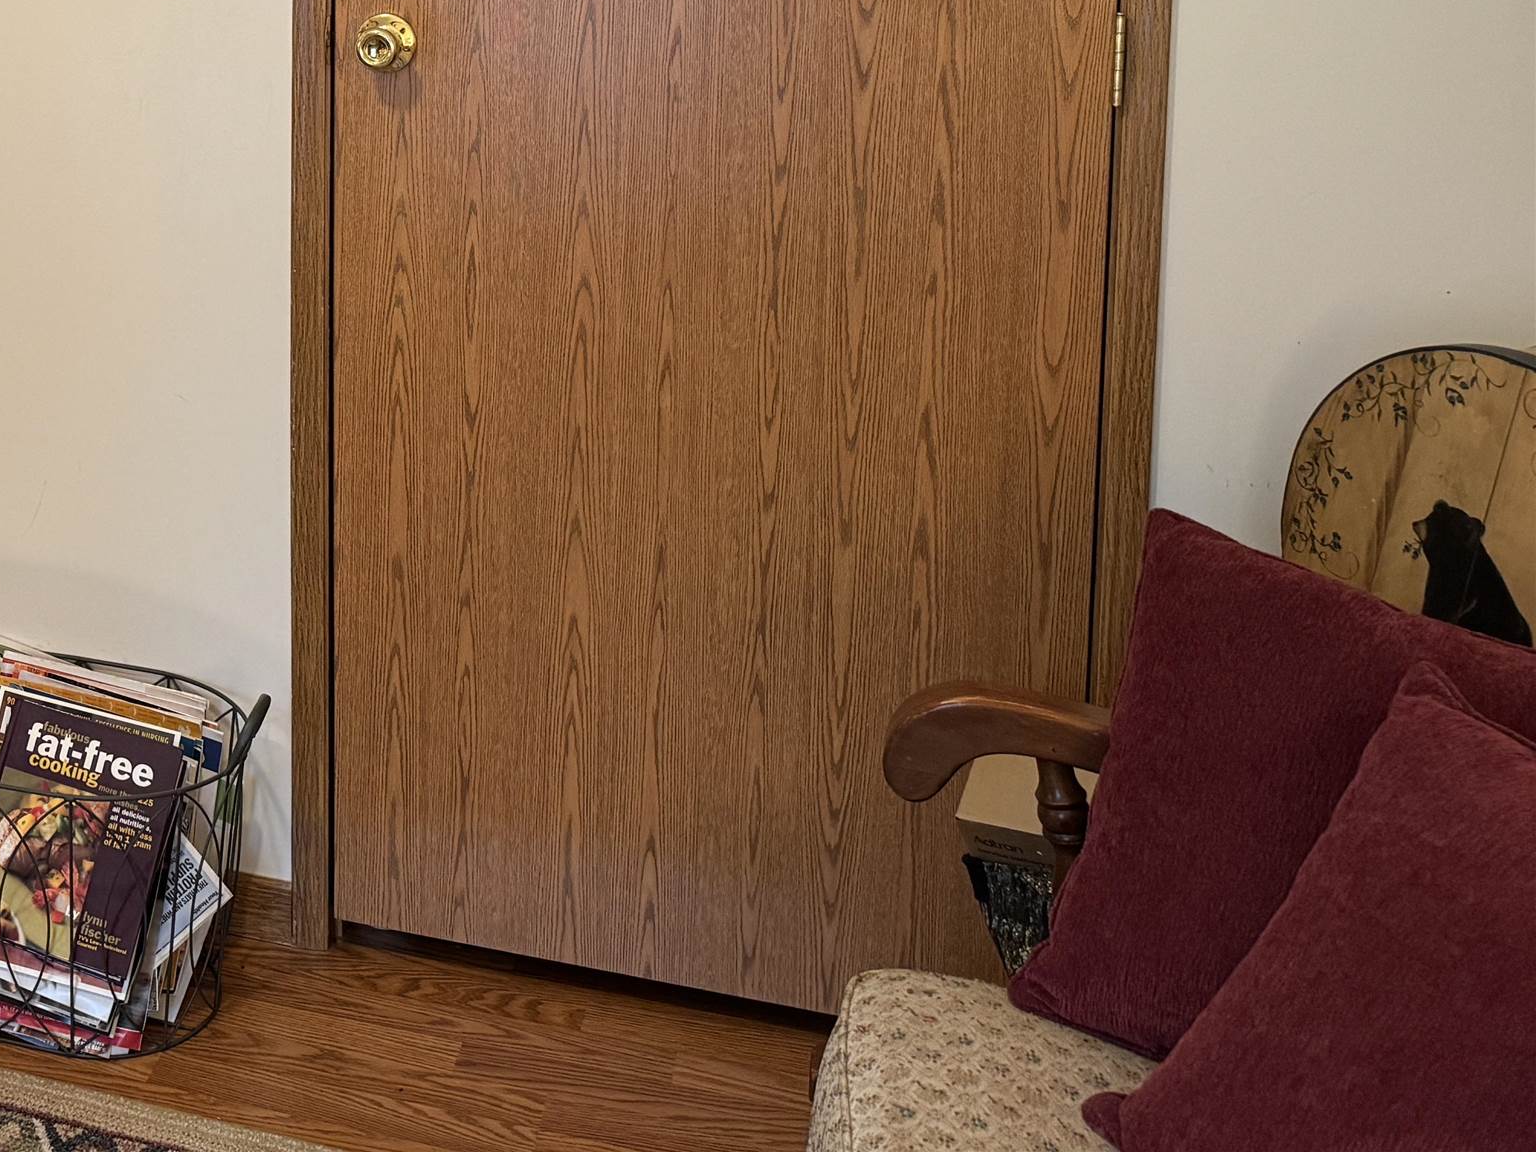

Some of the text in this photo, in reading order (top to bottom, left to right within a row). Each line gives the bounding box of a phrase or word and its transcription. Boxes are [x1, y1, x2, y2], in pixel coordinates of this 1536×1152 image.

[42, 721, 91, 744] fabulous
[26, 722, 154, 788] fat-free
[28, 753, 101, 789] cooking
[98, 785, 118, 794] more
[112, 806, 120, 814] all
[110, 814, 152, 833] all nutritios,
[120, 826, 136, 836] with
[164, 868, 204, 905] PROTEIN
[80, 924, 122, 945] fischer
